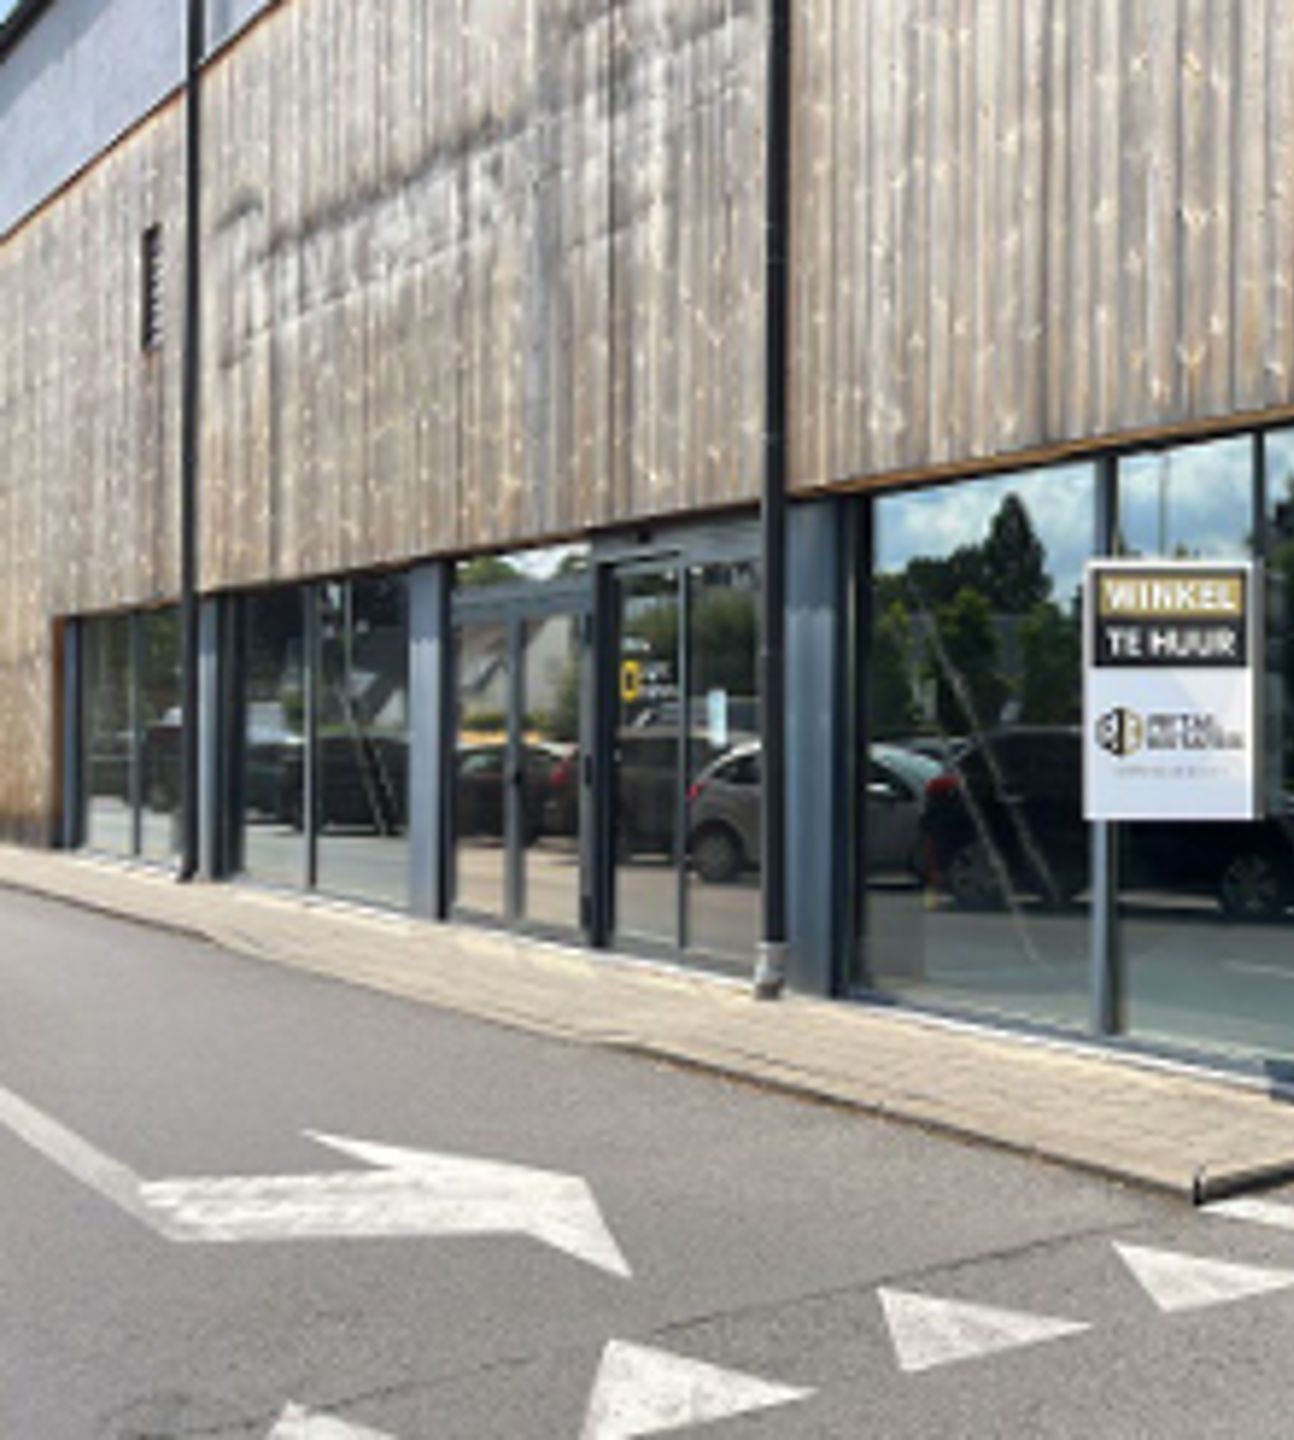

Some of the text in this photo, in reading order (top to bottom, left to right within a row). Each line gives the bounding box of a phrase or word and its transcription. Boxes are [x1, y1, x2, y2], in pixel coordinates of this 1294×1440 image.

[1106, 578, 1236, 611] WINKEL
[1106, 625, 1237, 657] TE HUUR
